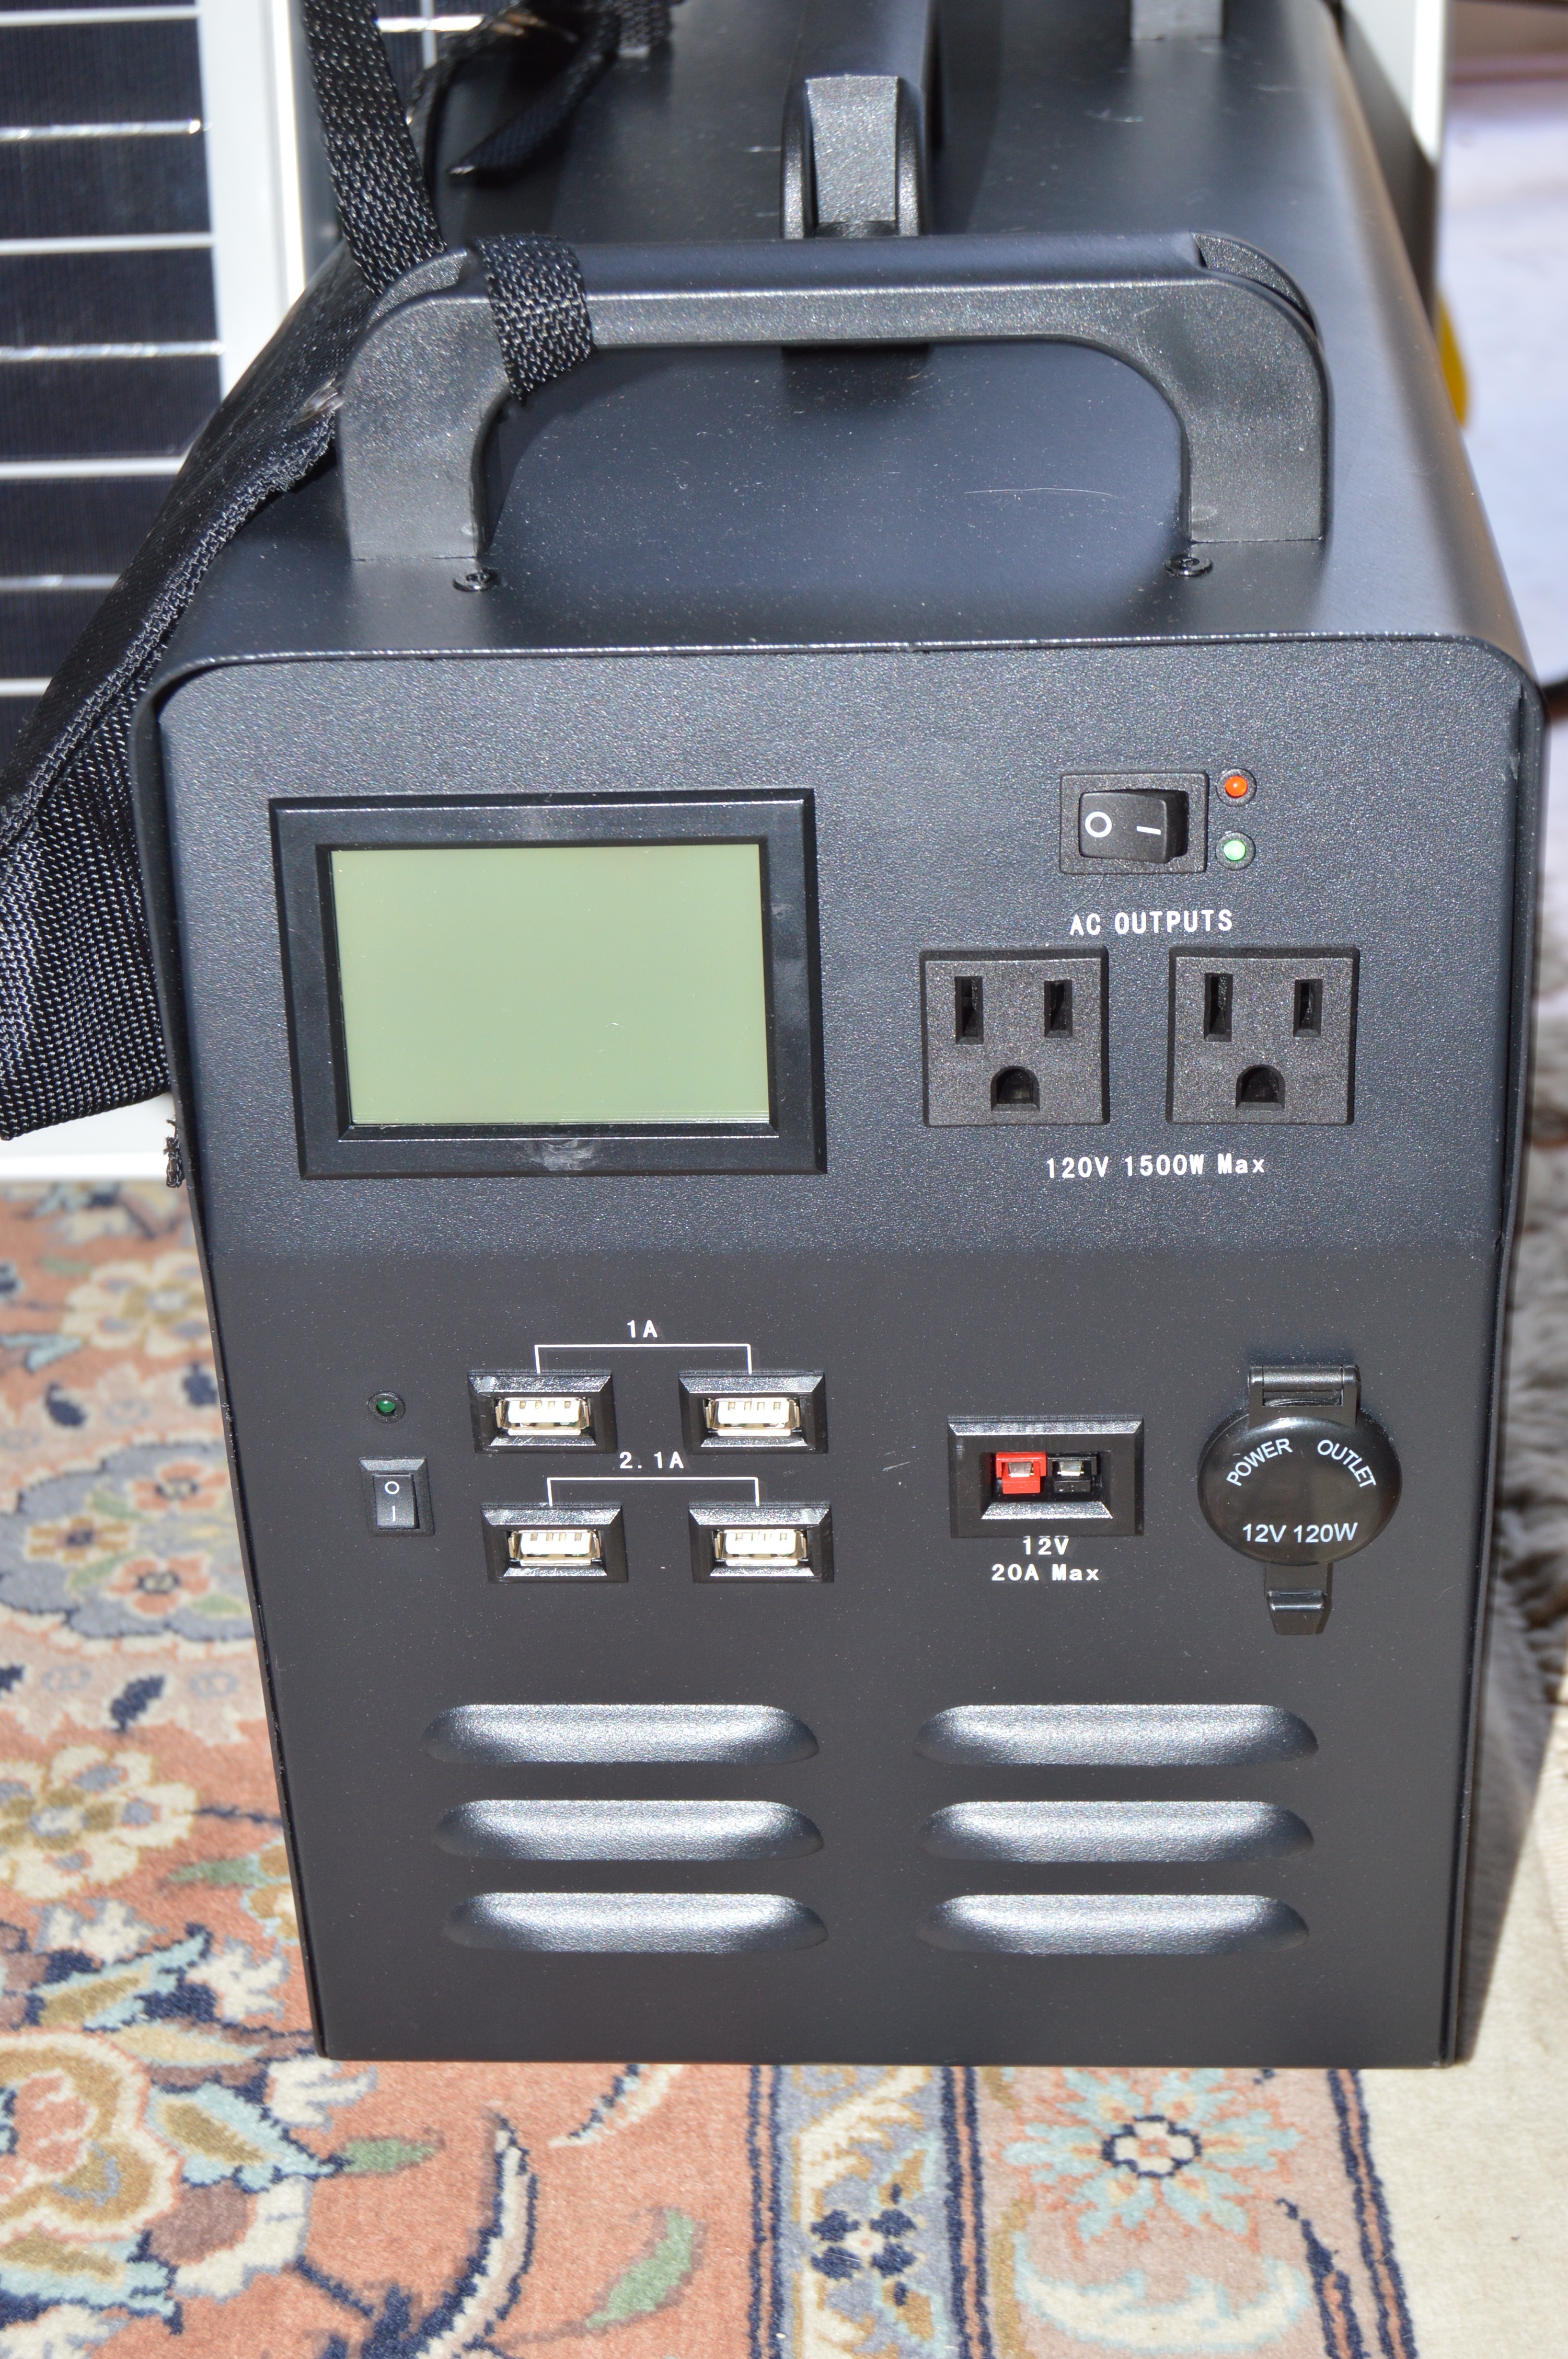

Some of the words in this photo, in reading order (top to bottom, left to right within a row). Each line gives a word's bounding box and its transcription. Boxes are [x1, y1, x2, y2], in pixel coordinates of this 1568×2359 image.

[1069, 912, 1101, 936] AC
[1114, 909, 1233, 935] OUTPUTS
[1046, 1155, 1109, 1180] 120V
[1124, 1153, 1204, 1177] 1500W
[1217, 1153, 1265, 1175] Max
[627, 1320, 658, 1338] 1A
[1226, 1438, 1293, 1487] POWER
[1317, 1439, 1377, 1488] OUTLET
[1242, 1523, 1287, 1543] 12V
[1293, 1522, 1358, 1543] 120W
[1023, 1538, 1069, 1555] 12V
[991, 1563, 1040, 1581] 20A
[1052, 1563, 1099, 1581] Max
